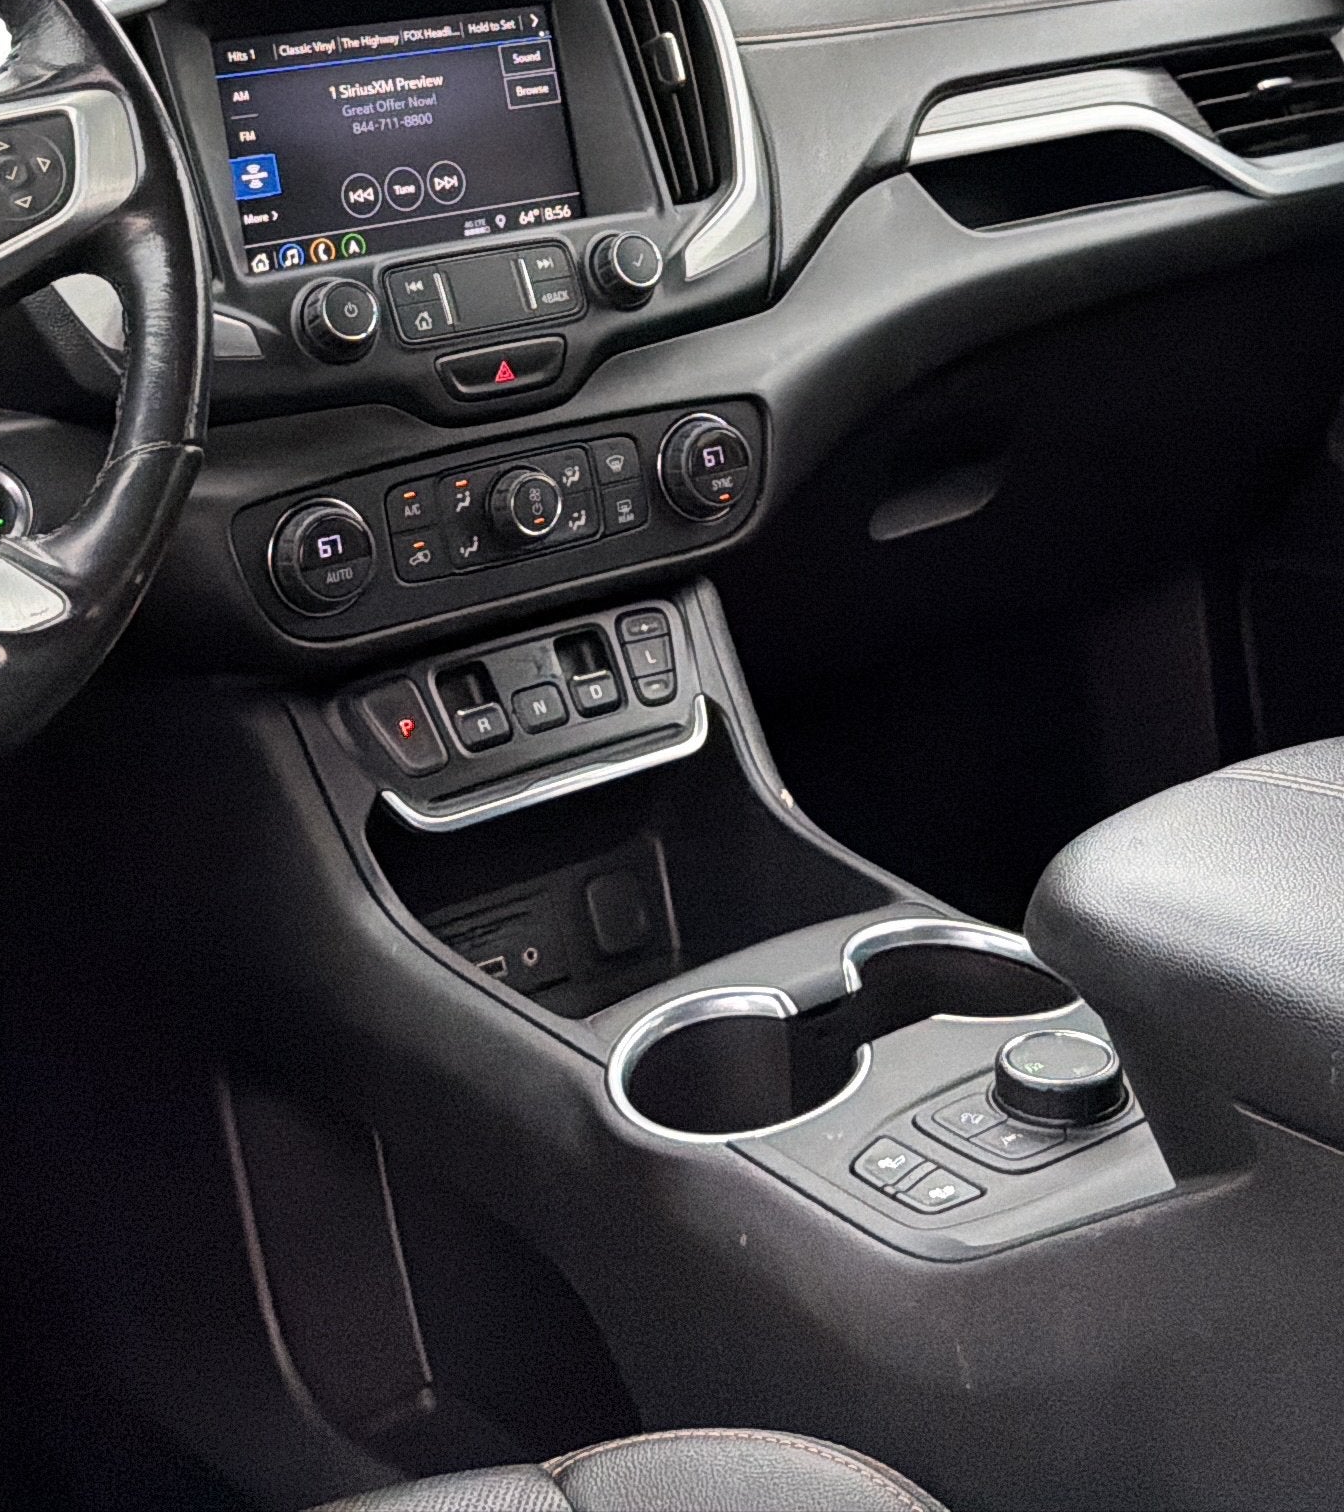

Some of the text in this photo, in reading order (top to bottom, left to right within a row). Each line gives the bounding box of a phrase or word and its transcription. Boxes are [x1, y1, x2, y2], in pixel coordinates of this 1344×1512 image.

[467, 19, 516, 35] Hold to Set
[341, 33, 400, 50] The Highway
[403, 29, 423, 42] FOX
[278, 39, 337, 57] Classic Vinyl
[227, 50, 249, 64] Hits
[512, 50, 542, 65] Sound
[328, 74, 445, 101] 1 SiriusXM Preview
[515, 84, 550, 98] Browse
[232, 89, 251, 104] AM
[341, 91, 438, 119] Great Offer Now!
[352, 111, 434, 136] 844-711-8800
[239, 129, 257, 143] FM
[392, 184, 417, 197] Tune
[242, 212, 271, 226] More
[543, 203, 573, 222] 8:56
[547, 289, 570, 305] BACK
[701, 444, 726, 468] 67
[710, 476, 734, 492] SYNC
[404, 503, 422, 520] A/C
[617, 512, 635, 525] REAR
[316, 534, 344, 560] 67
[325, 567, 354, 585] AUTO
[644, 649, 657, 665] L
[589, 683, 603, 701] D
[532, 700, 548, 716] N
[397, 717, 416, 739] P
[476, 716, 493, 734] R
